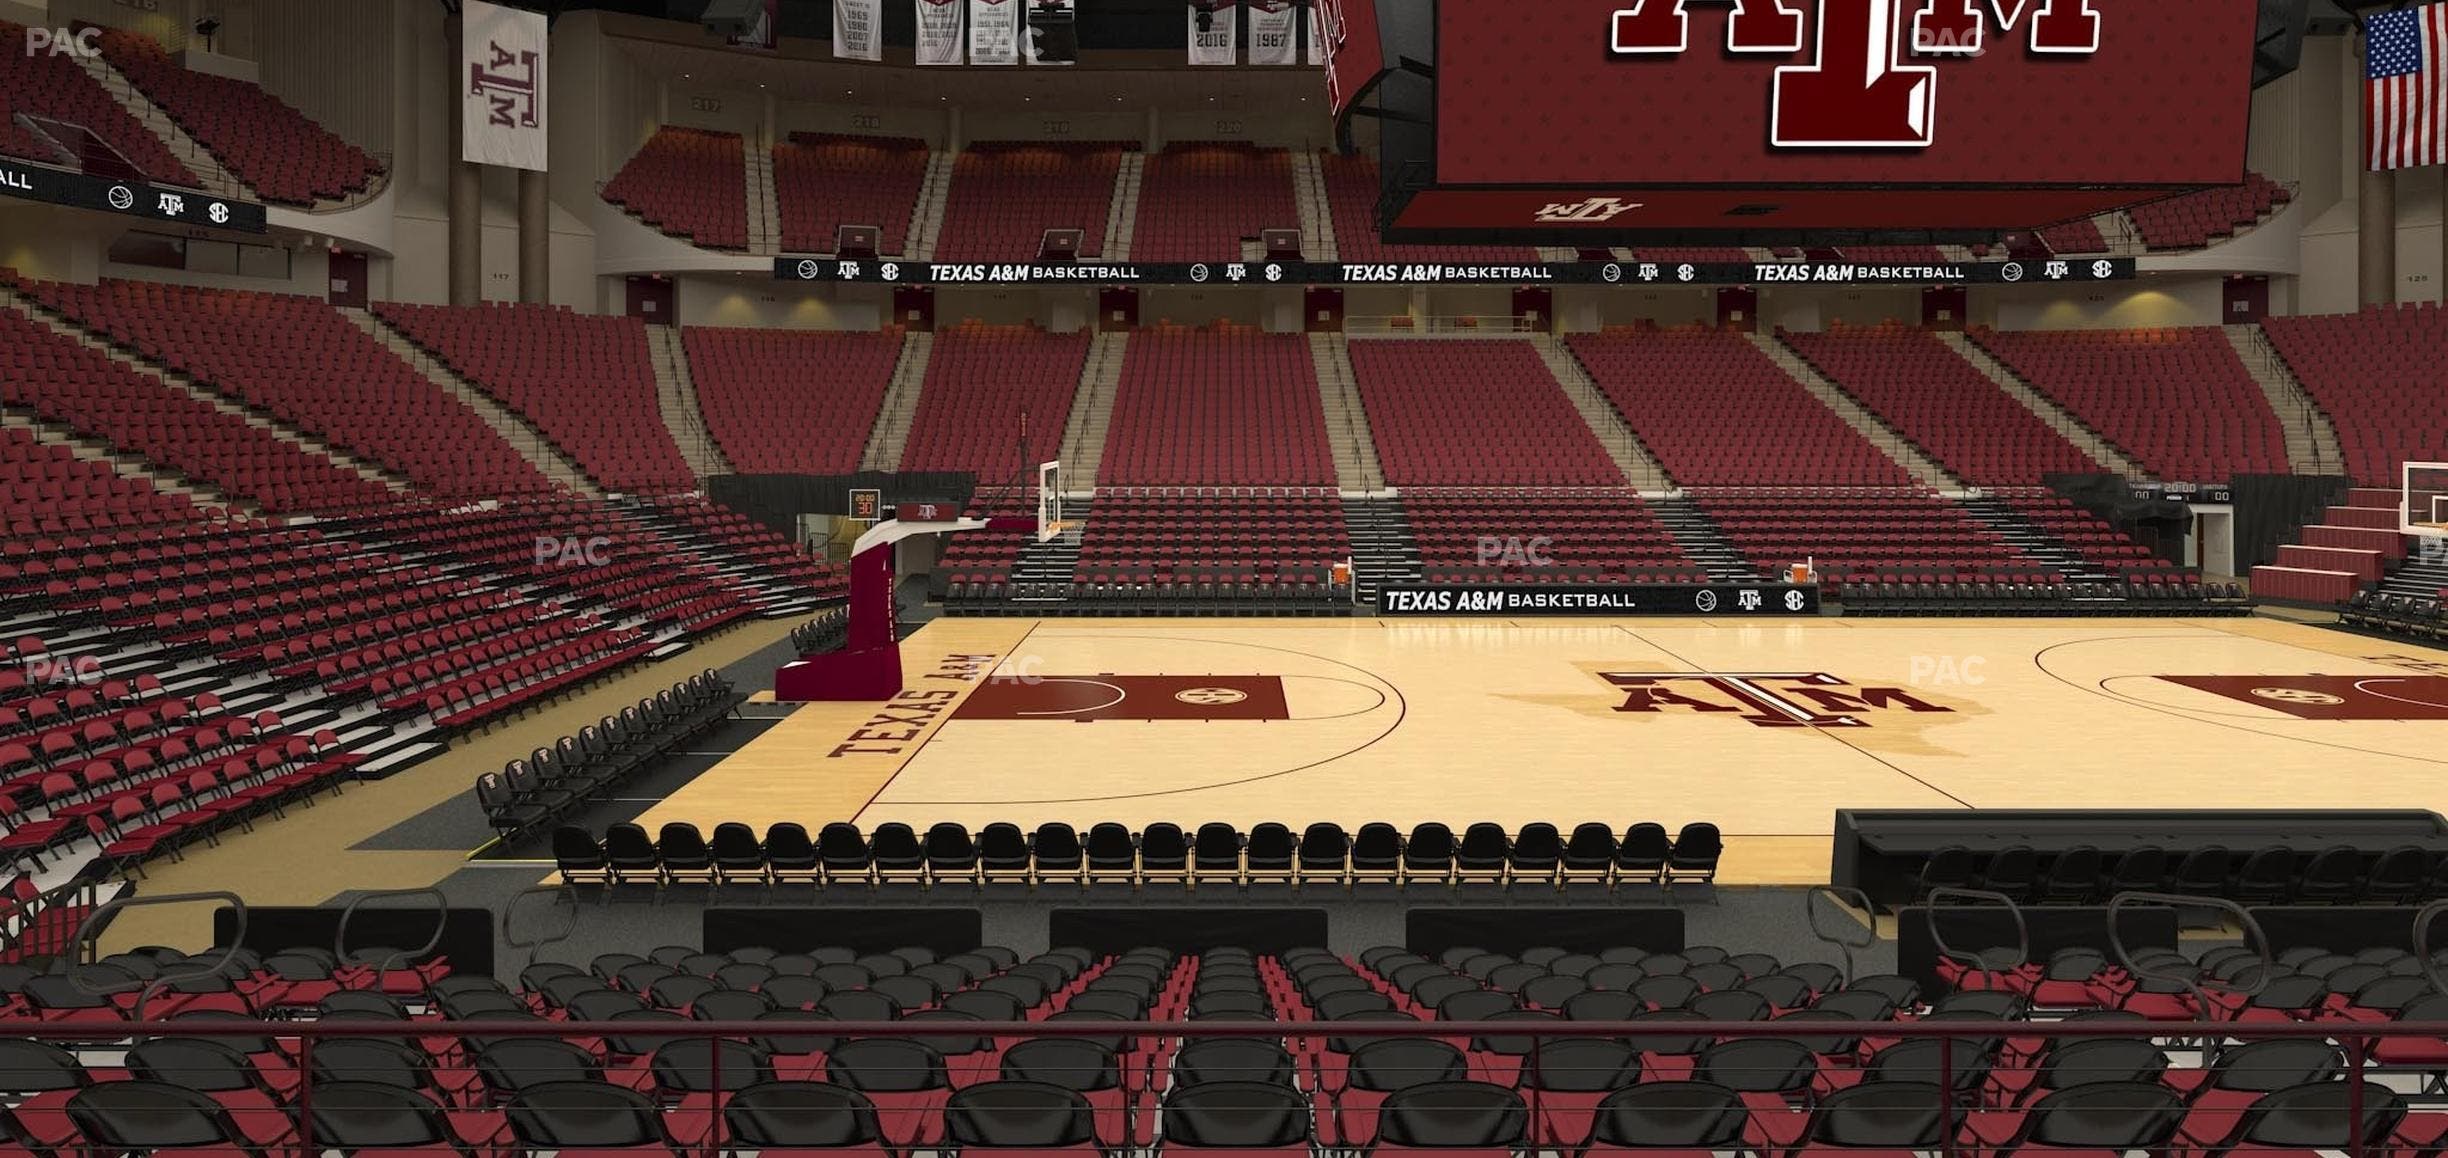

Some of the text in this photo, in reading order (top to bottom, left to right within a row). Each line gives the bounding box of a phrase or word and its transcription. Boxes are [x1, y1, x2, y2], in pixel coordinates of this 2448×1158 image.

[1197, 33, 1228, 47] 2016
[1256, 33, 1287, 47] 1987
[208, 202, 229, 224] SEC
[881, 262, 899, 281] SEC
[930, 265, 1140, 281] TEXAS A&M BASKETBALL
[1265, 263, 1282, 282] SEC
[1342, 265, 1552, 281] TEXAS A&M BASKETBALL
[1677, 263, 1695, 282] SEC
[1754, 265, 1965, 281] TEXAS A&M BASKETBALL
[2092, 260, 2112, 279] SEC
[2215, 491, 2229, 501] 00
[858, 502, 872, 514] 30
[1386, 591, 1635, 611] TEXAS A&M BASKETBALL
[1784, 590, 1805, 611] SEC
[827, 690, 958, 757] TEXAS
